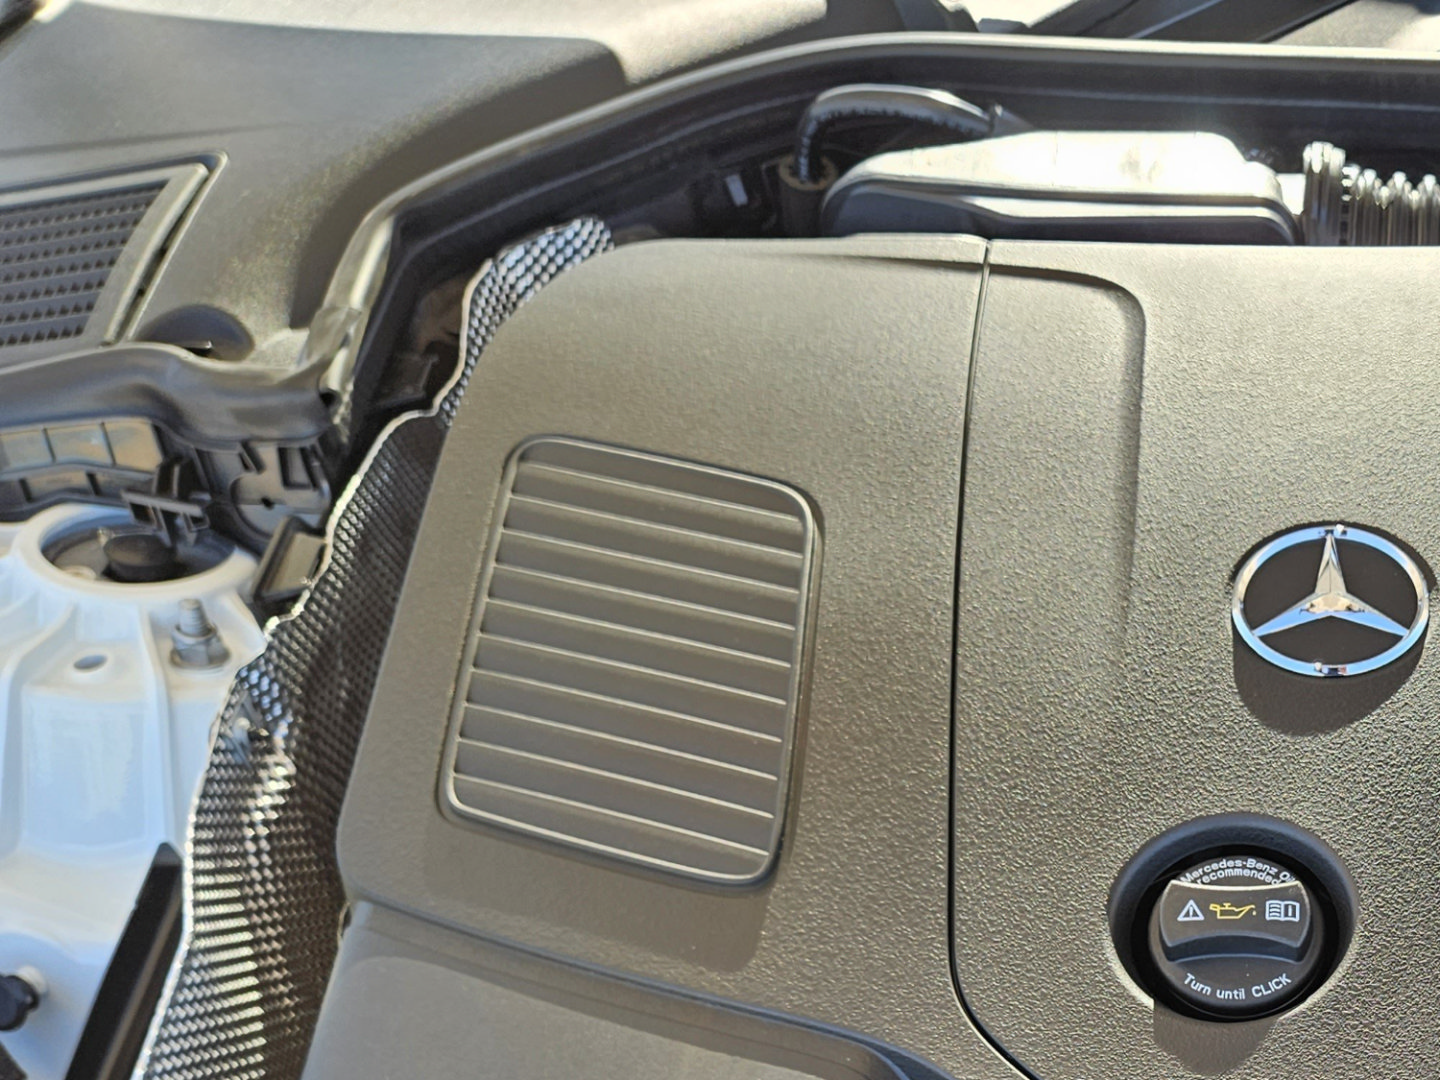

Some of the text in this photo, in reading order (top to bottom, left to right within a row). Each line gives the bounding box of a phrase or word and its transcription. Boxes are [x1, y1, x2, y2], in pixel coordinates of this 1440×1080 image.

[1180, 858, 1278, 884] Mercedes-Benz
[1196, 867, 1281, 886] recommended
[1183, 972, 1292, 1000] Turn until CLICK
